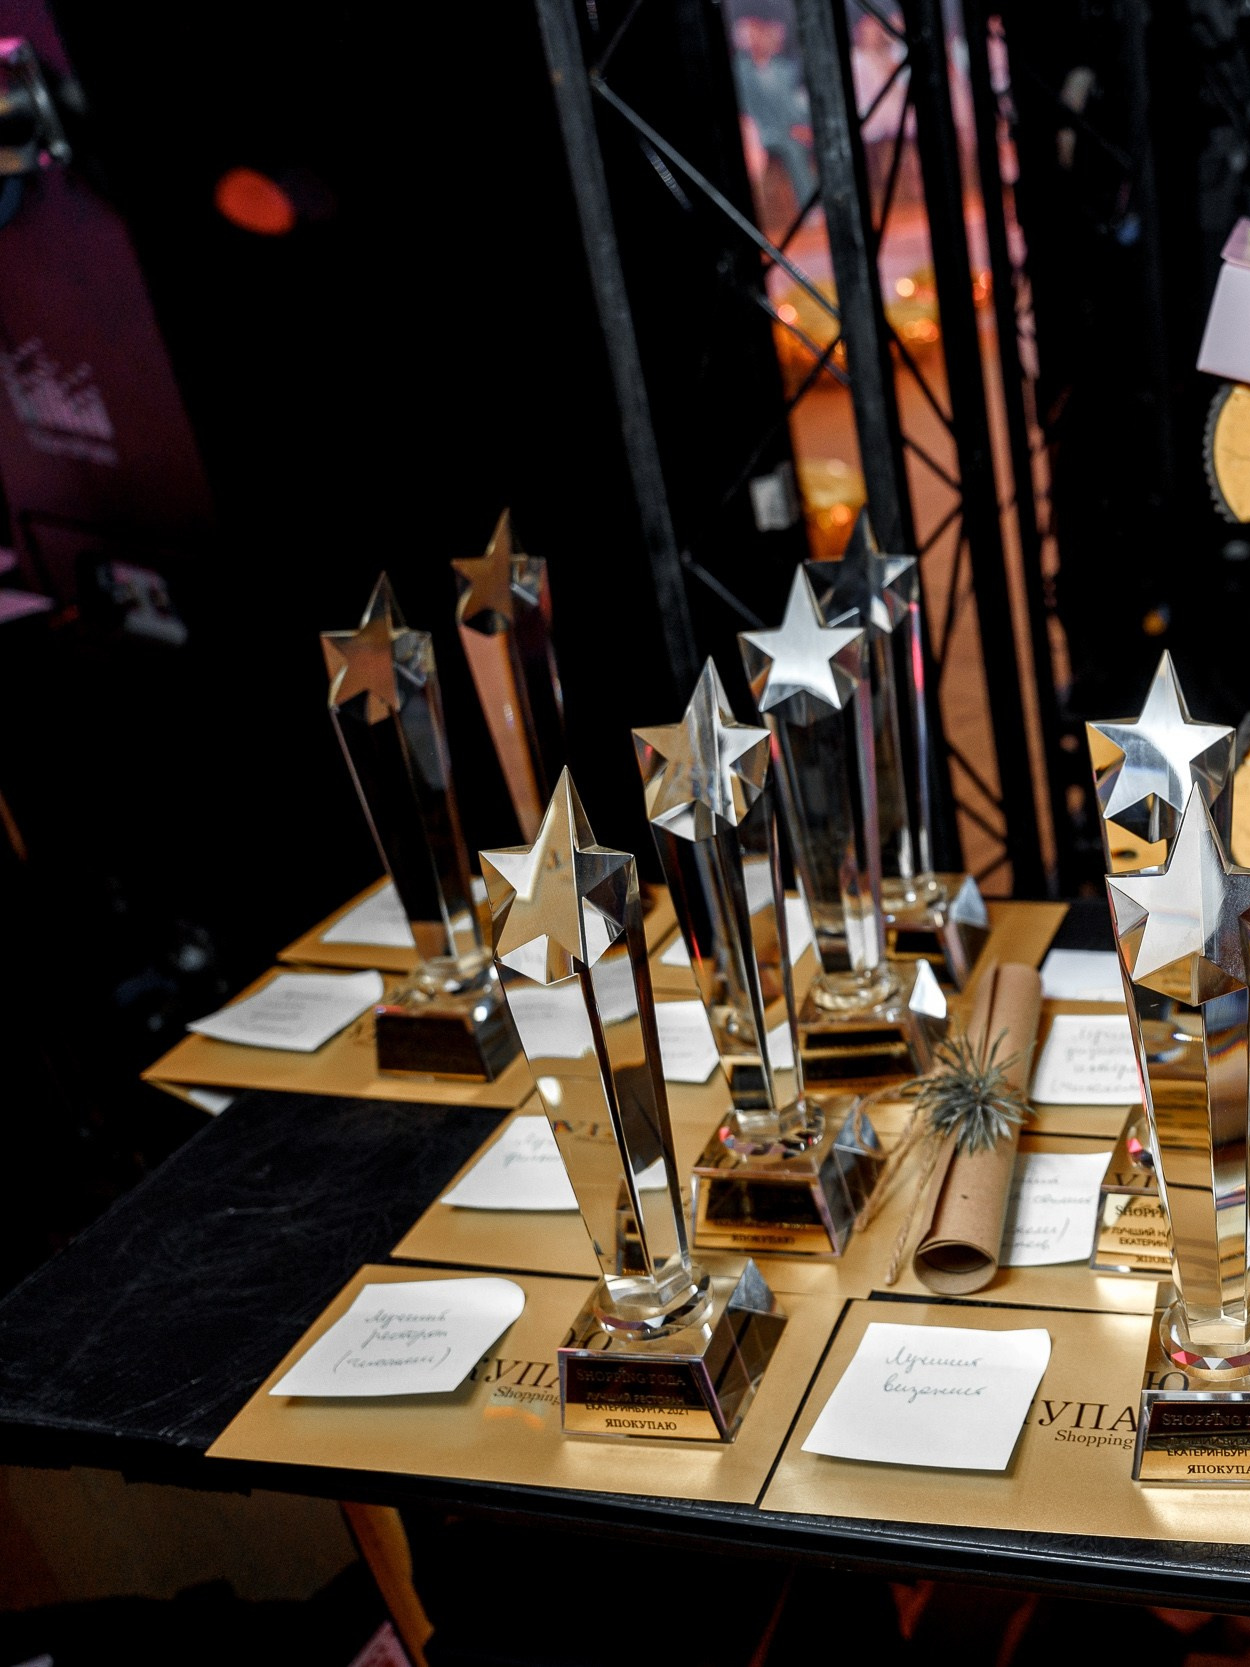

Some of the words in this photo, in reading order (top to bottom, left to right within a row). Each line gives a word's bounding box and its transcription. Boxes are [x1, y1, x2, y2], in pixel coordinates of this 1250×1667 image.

[1118, 1236, 1168, 1248] ЕКАТЕРИН
[605, 1418, 678, 1431] ЯПОКУПАЮ
[1161, 1411, 1243, 1427] SHOPPING
[1054, 1429, 1135, 1450] Shopping
